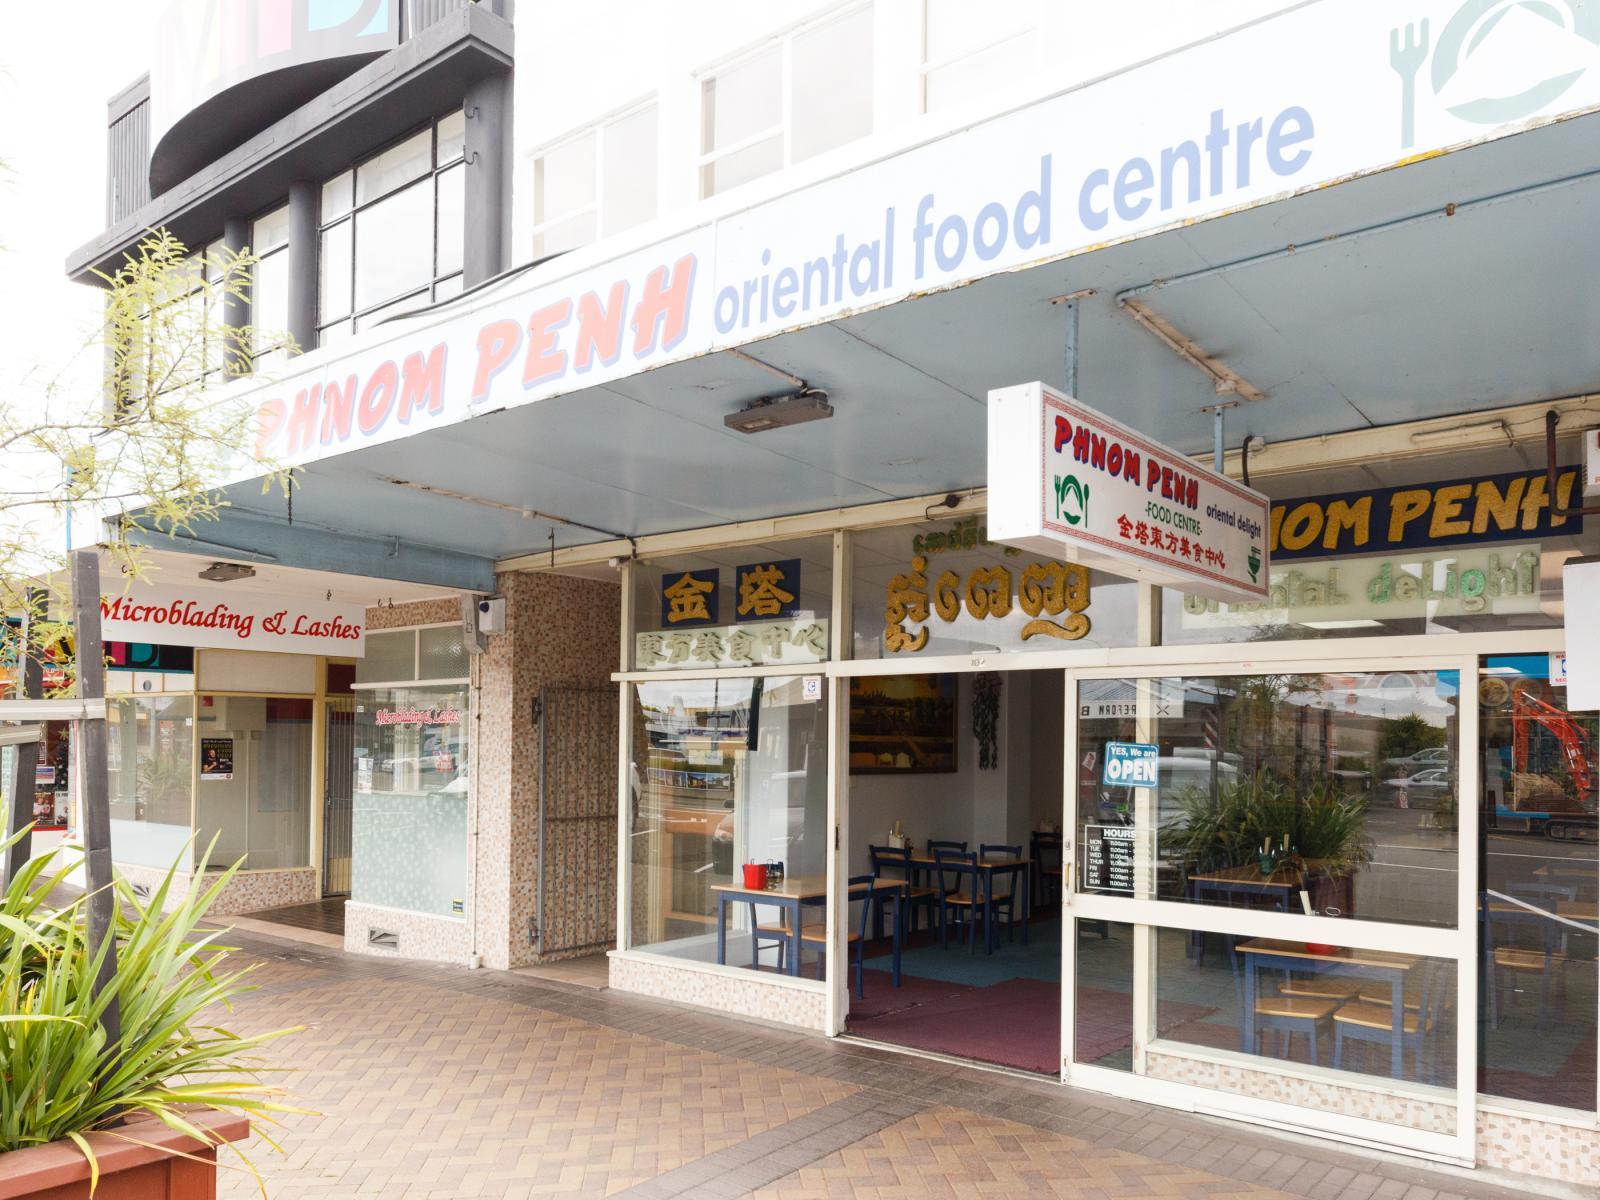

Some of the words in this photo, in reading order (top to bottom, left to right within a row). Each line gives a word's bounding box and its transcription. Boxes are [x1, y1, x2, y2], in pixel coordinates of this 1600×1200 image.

[254, 341, 448, 462] PHNOM
[471, 252, 699, 404] PENH
[713, 206, 895, 335] oriental
[912, 152, 1053, 281] food
[1078, 105, 1315, 232] centre
[1054, 414, 1142, 487] PHNOM
[1146, 458, 1200, 511] PENH
[1206, 503, 1236, 528] oriental
[1237, 514, 1262, 539] delight
[1387, 471, 1577, 542] PENH
[1116, 513, 1226, 570] 金塔東方美食中心
[663, 563, 796, 624] 金塔
[100, 596, 254, 639] Microblading
[262, 610, 287, 635] &
[291, 615, 361, 640] Lashes
[637, 623, 826, 666] 東方美食中心
[1108, 758, 1156, 782] OPEN
[1111, 746, 1129, 757] YES,
[1130, 748, 1143, 757] We
[1143, 750, 1156, 758] are
[1103, 828, 1137, 839] HOURS
